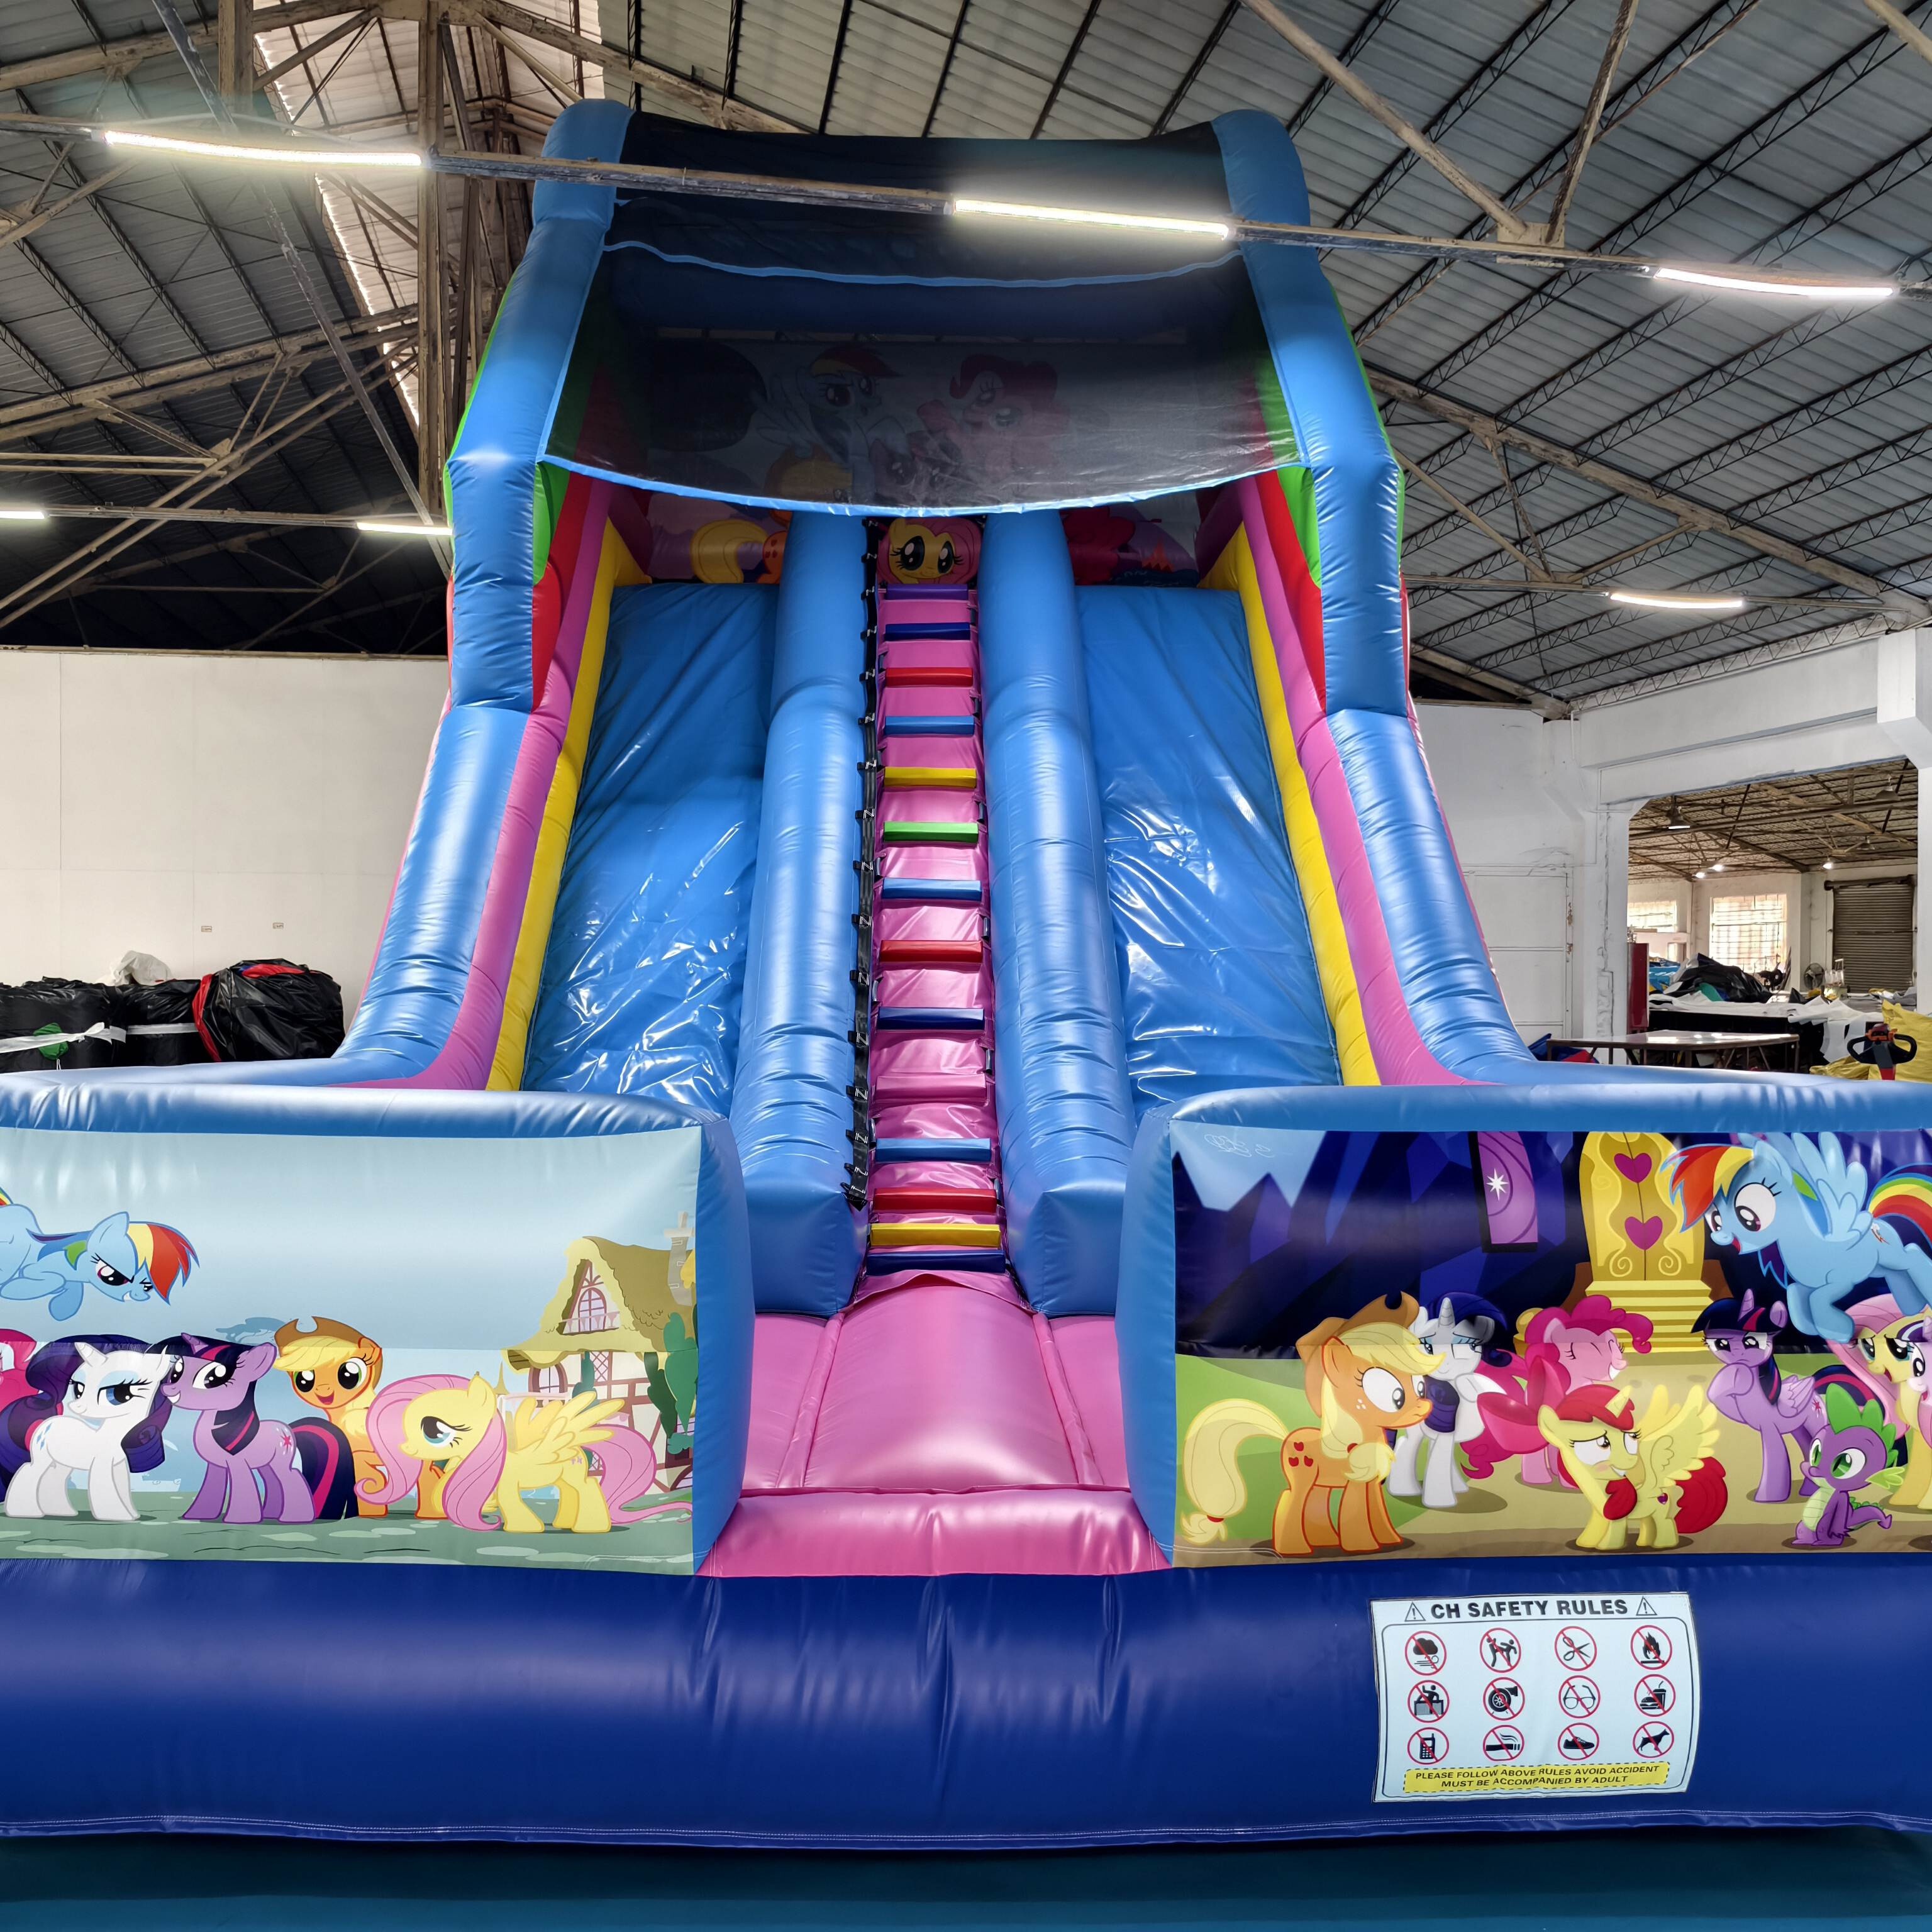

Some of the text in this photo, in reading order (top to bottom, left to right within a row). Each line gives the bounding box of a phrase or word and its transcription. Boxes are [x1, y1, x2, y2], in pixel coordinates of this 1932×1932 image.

[1431, 1599, 1628, 1619] CH SAFETY RULES
[1457, 1769, 1499, 1779] FOLLOW
[1538, 1768, 1572, 1776] RULES
[1609, 1765, 1660, 1774] ACCIDENT
[1492, 1777, 1572, 1785] ACCOMPANIED
[1591, 1775, 1628, 1784] ADULT
